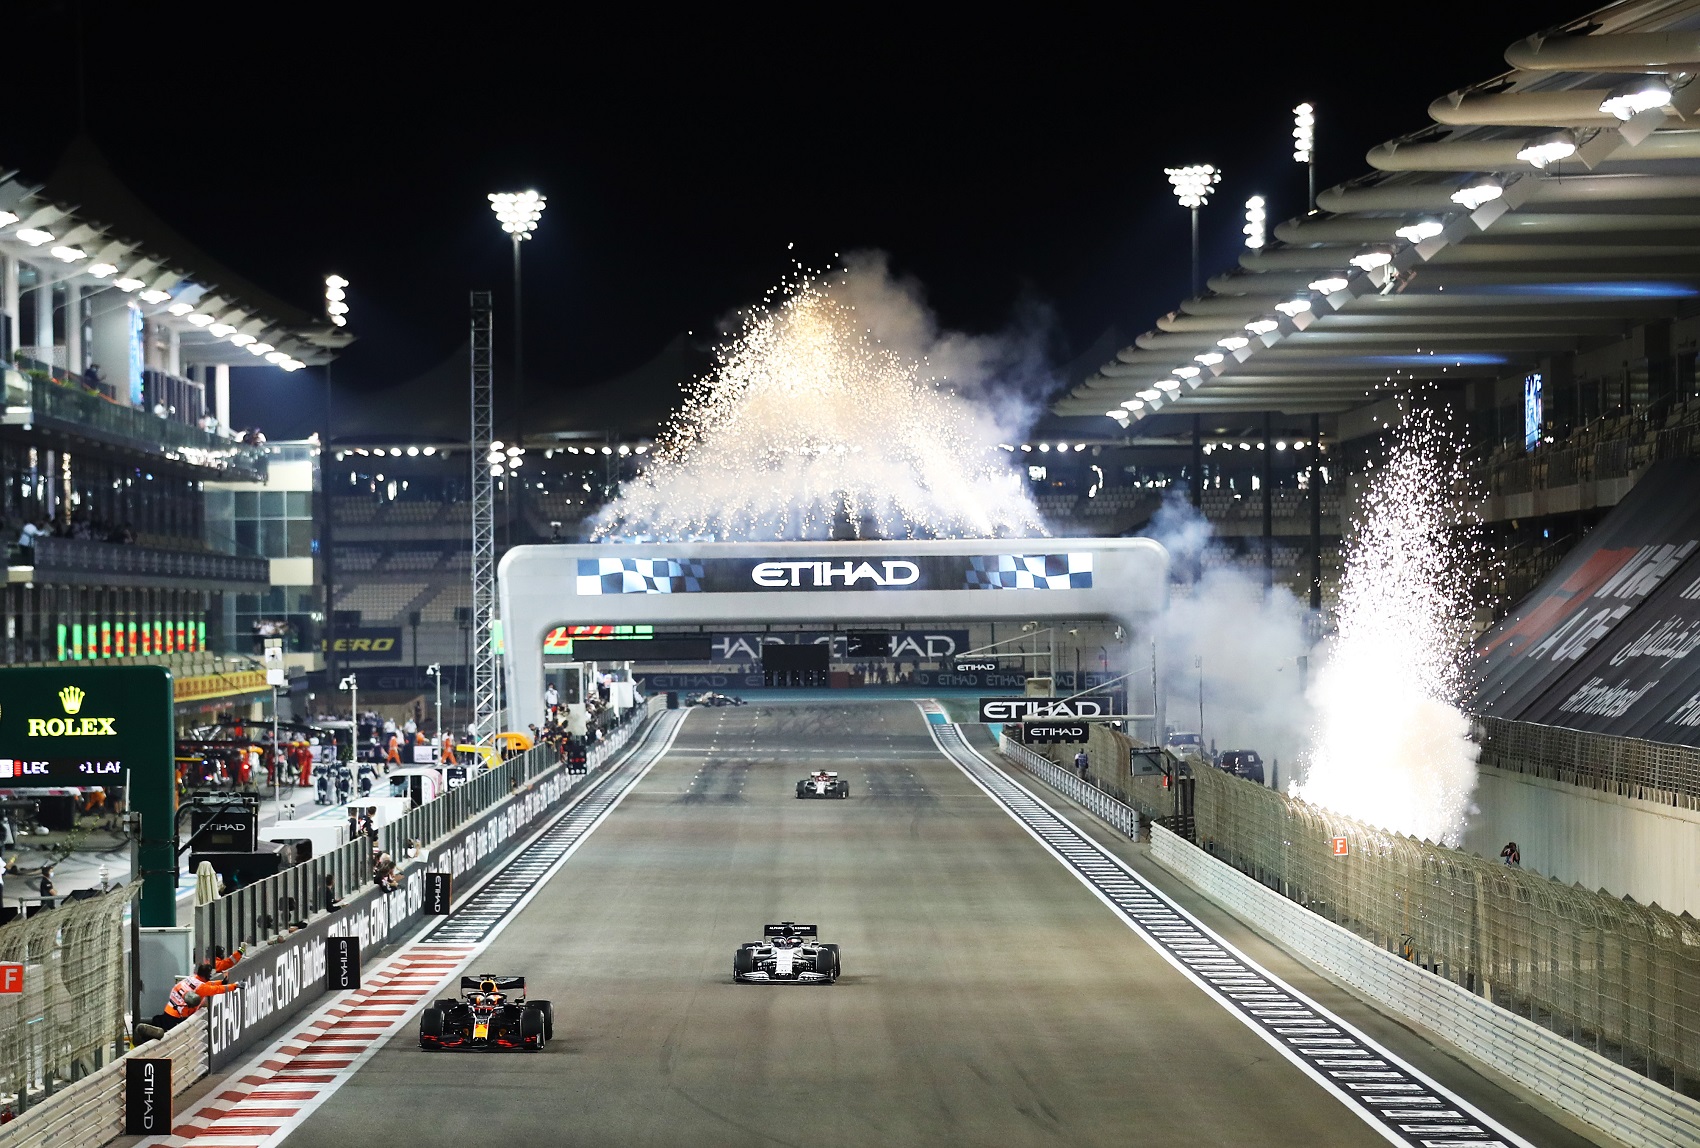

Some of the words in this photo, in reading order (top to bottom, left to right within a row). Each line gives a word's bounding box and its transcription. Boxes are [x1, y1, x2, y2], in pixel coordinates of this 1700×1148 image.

[752, 560, 921, 587] ETIHAD
[322, 638, 395, 651] ERO
[653, 675, 728, 687] ETIHAD
[983, 701, 1101, 719] ETIHAD
[28, 717, 118, 736] ROLEX
[1030, 727, 1083, 736] ETIHAD
[23, 761, 49, 774] LEC
[79, 761, 94, 773] +1
[1336, 839, 1344, 852] F
[434, 875, 442, 913] ETIHAD
[340, 940, 348, 987] ETIHAD
[5, 968, 18, 990] F
[276, 944, 300, 1010] ETIHAD
[211, 987, 241, 1055] ETIHAD
[144, 1062, 154, 1130] ETIHAD
